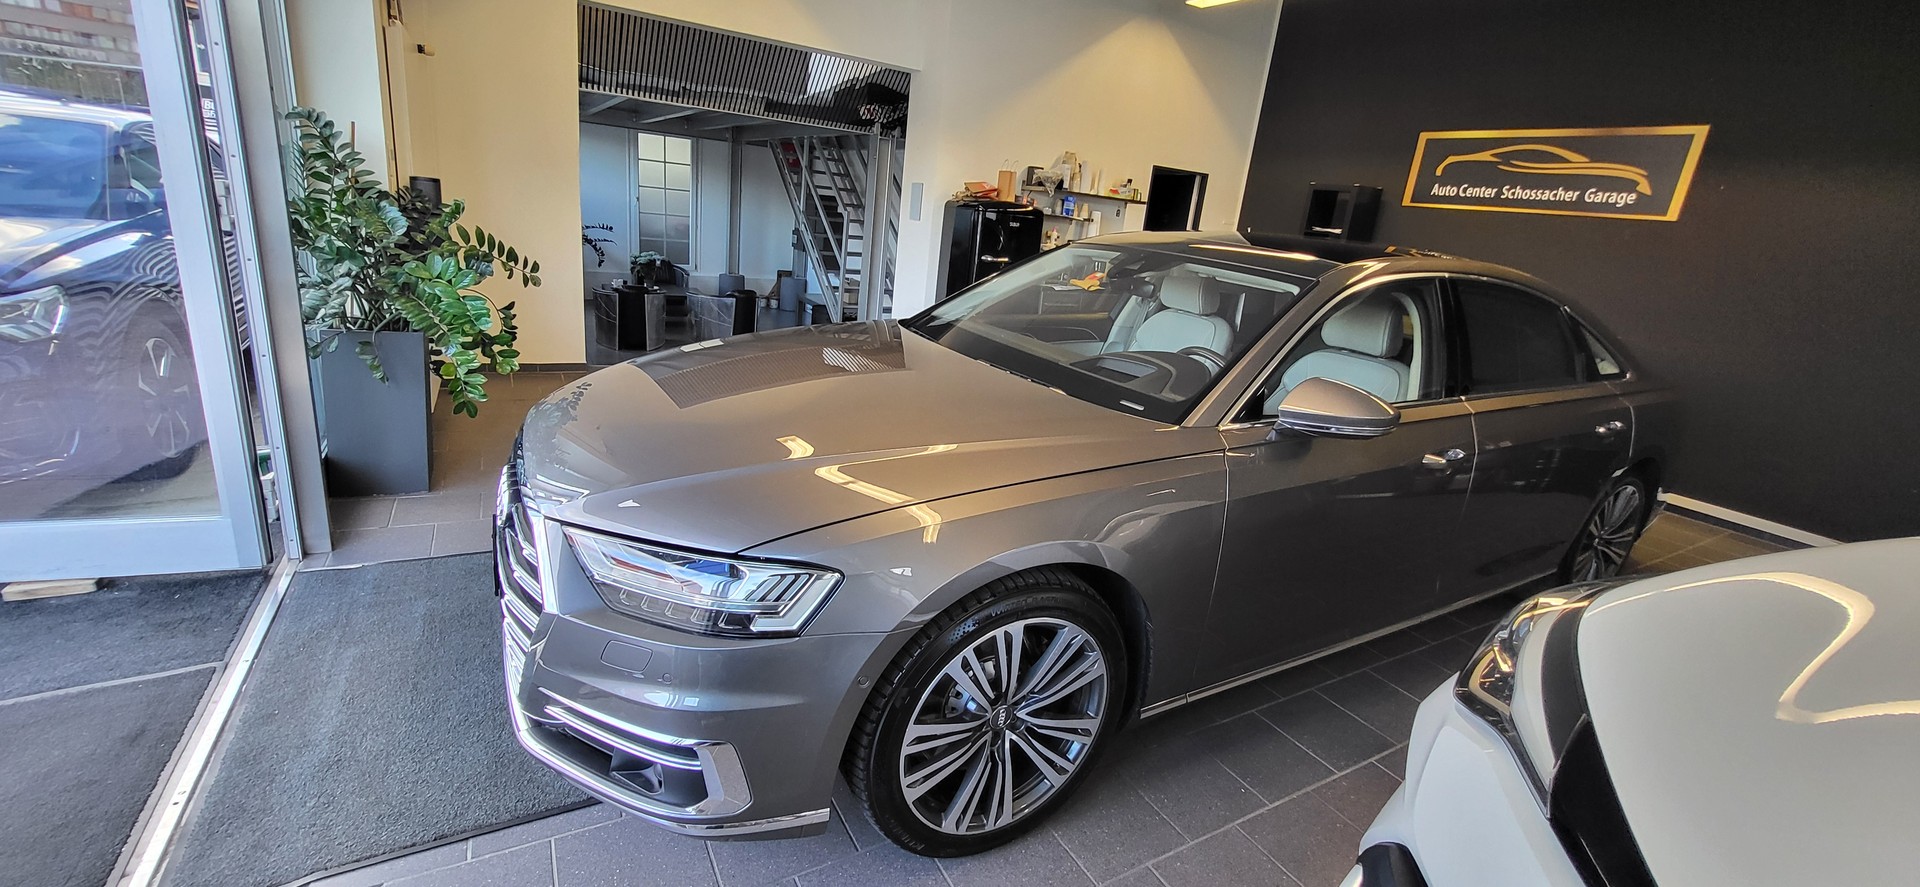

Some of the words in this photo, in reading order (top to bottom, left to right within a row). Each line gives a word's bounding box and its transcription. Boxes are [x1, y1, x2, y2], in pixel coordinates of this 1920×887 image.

[1430, 183, 1458, 197] Auto
[1458, 183, 1498, 198] Center
[1500, 185, 1581, 201] Schossacher
[1584, 187, 1638, 207] Garage
